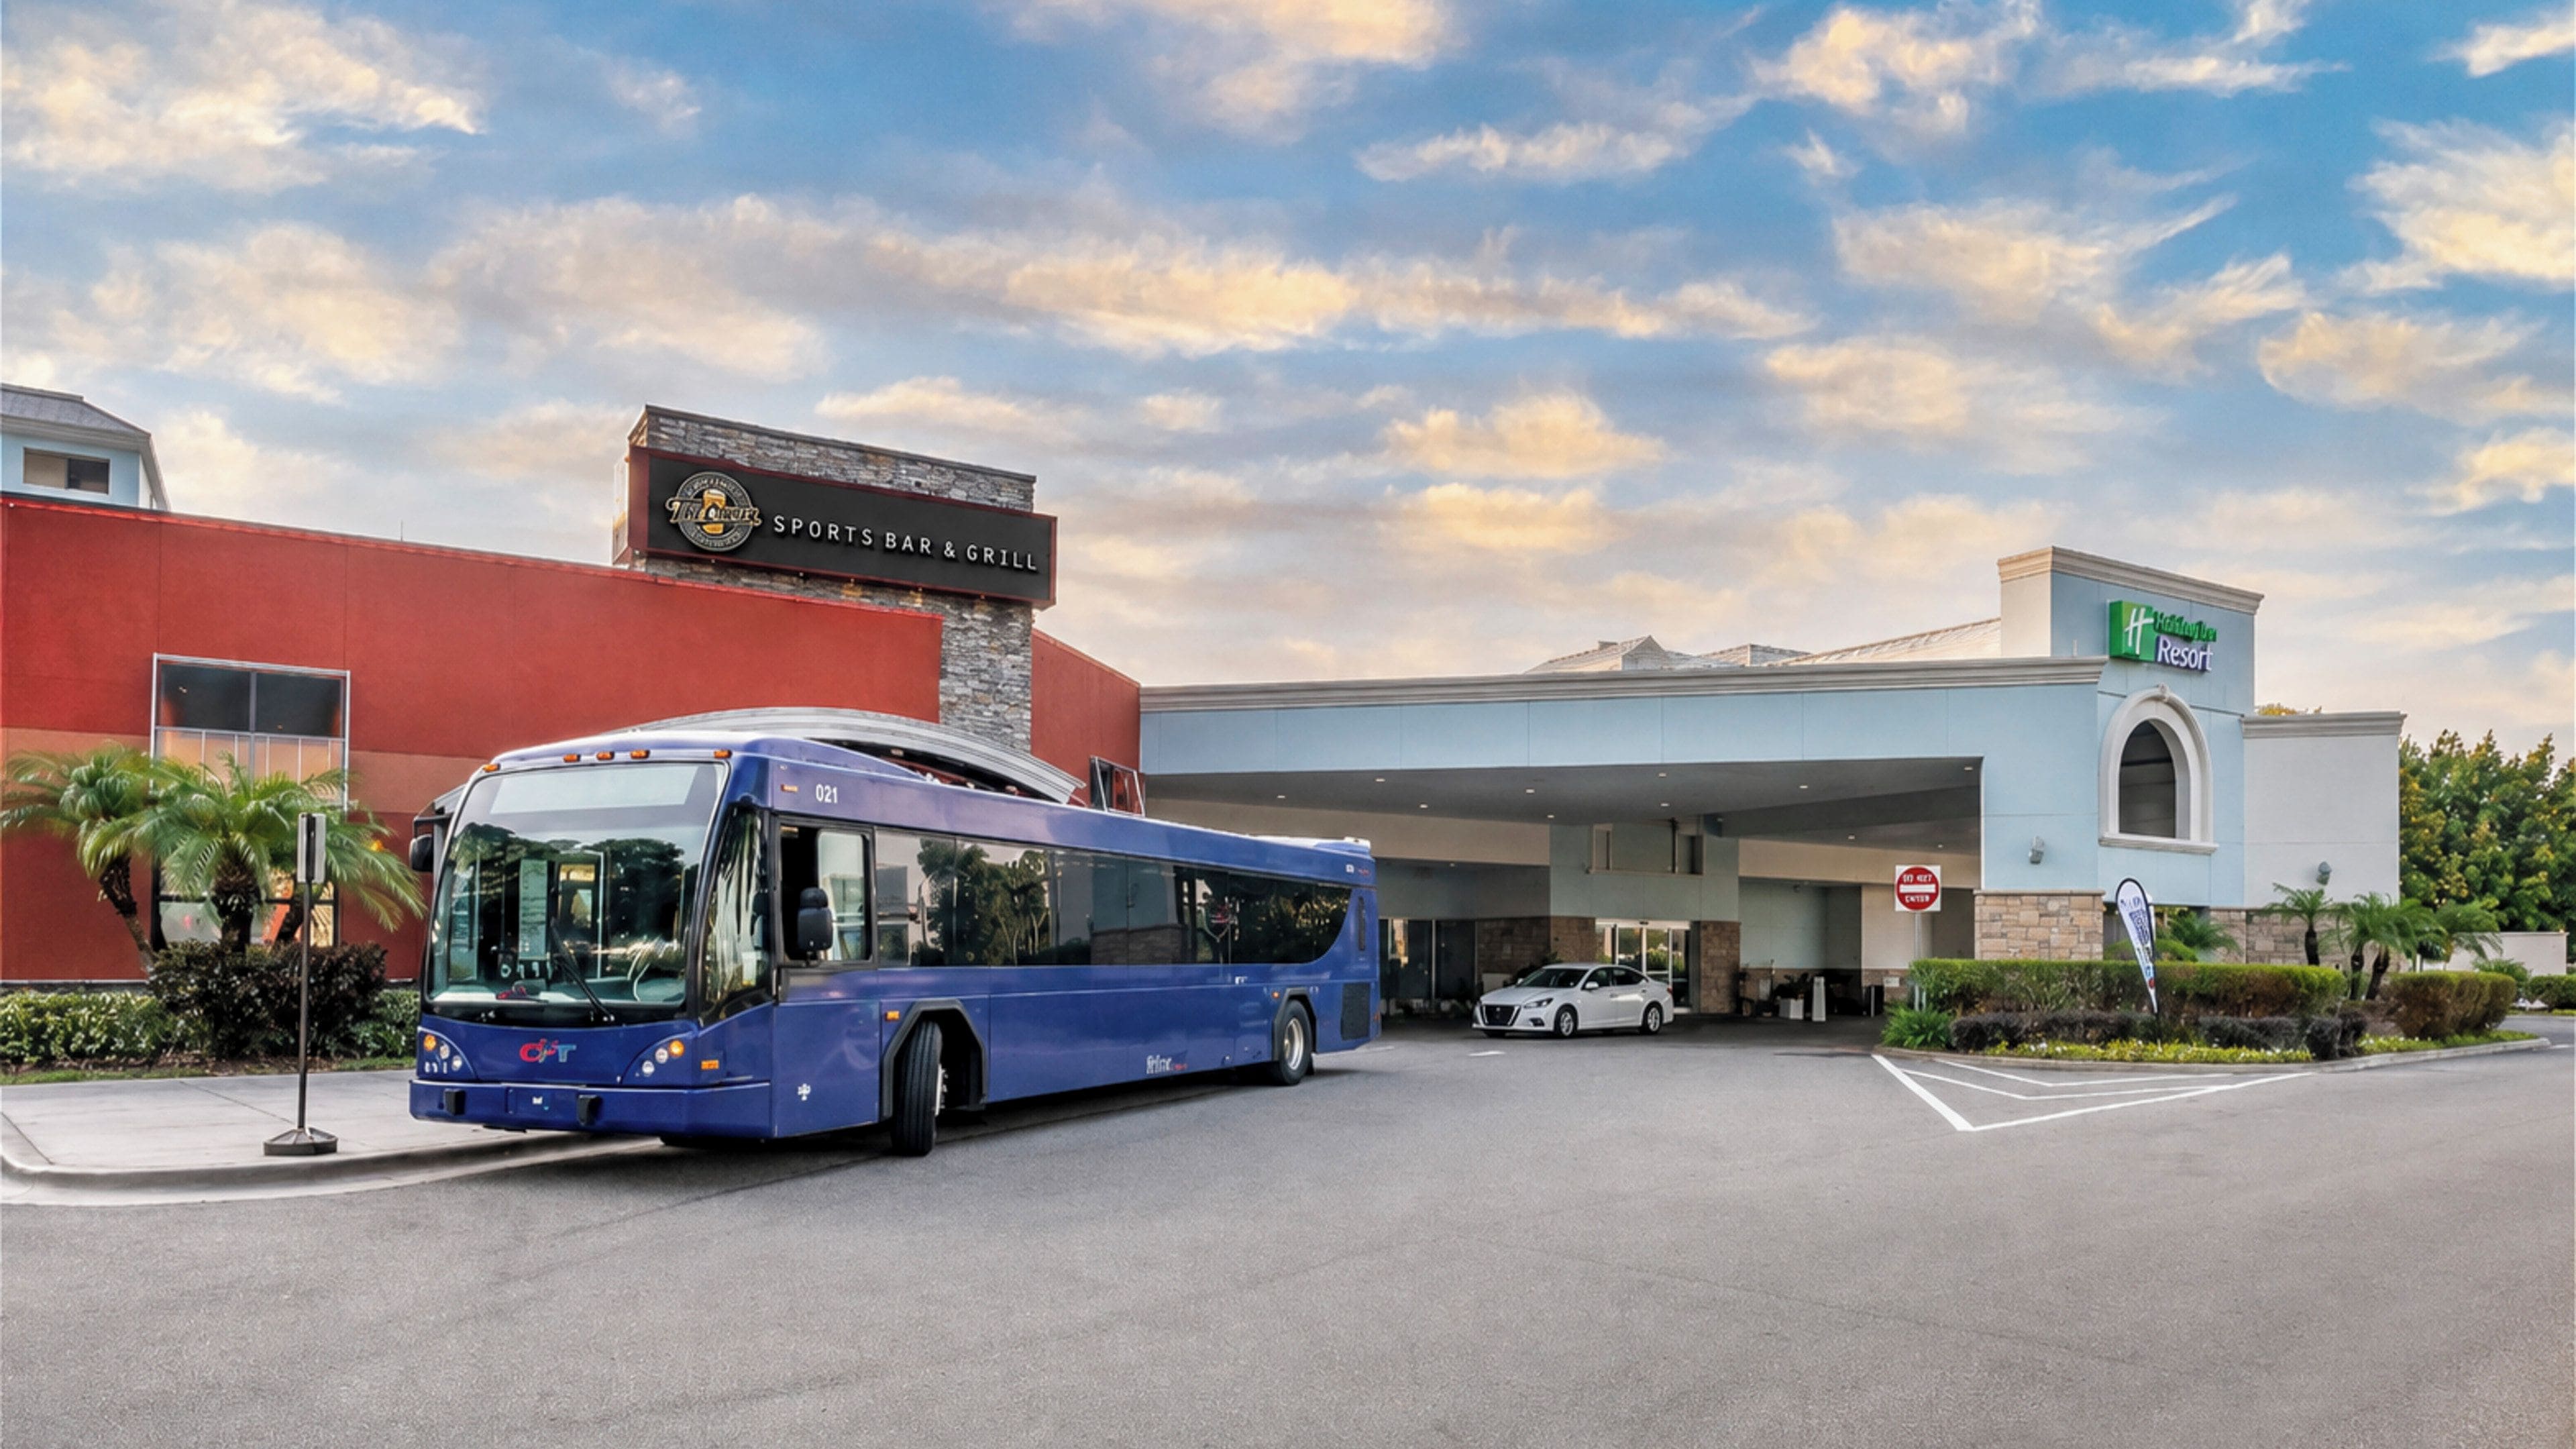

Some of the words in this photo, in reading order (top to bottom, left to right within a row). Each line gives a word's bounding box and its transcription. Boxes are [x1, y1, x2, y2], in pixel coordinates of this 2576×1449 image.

[773, 515, 873, 545] SPORTS
[885, 532, 931, 554] BAR
[943, 540, 956, 559] &
[967, 543, 1037, 570] GRILL
[2157, 635, 2214, 671] Resort
[816, 784, 838, 804] 021
